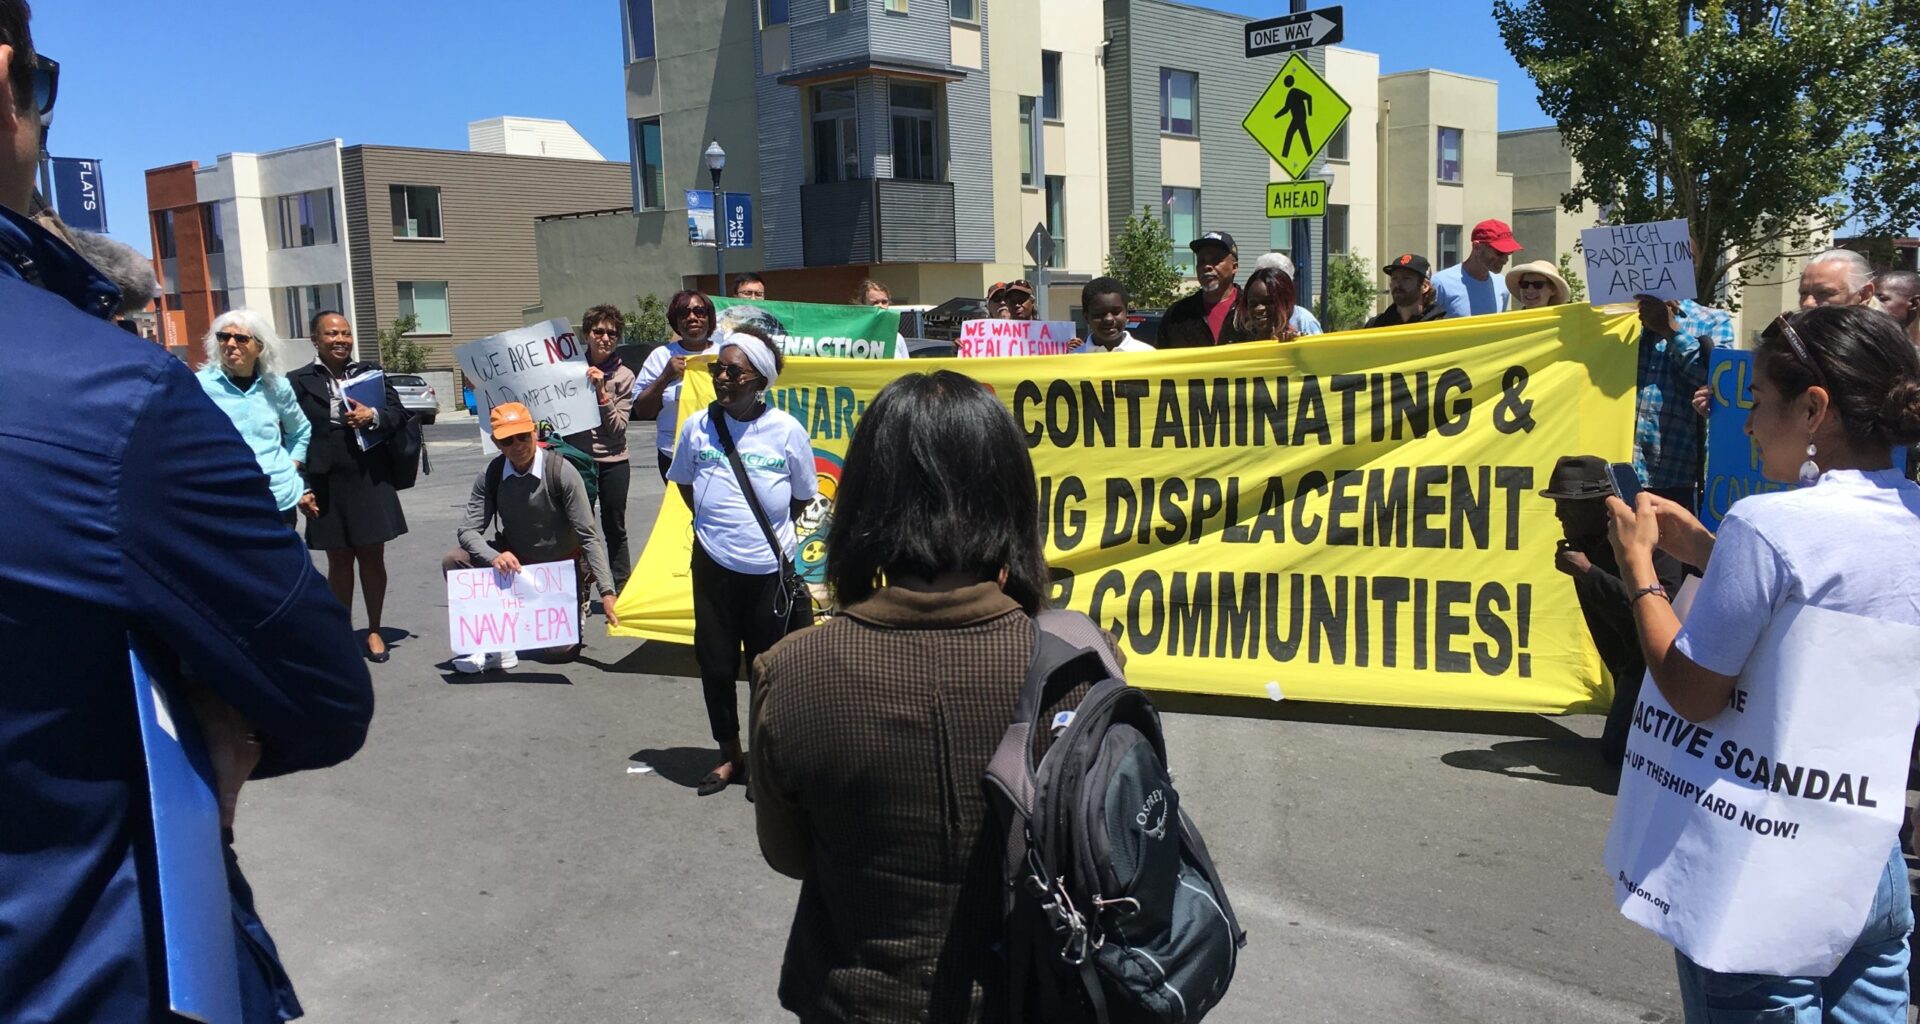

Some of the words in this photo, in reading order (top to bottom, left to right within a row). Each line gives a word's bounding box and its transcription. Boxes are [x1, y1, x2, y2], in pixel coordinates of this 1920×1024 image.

[1254, 28, 1280, 46] ONE
[1285, 22, 1313, 42] WAY
[79, 161, 96, 211] FLATS
[1273, 190, 1319, 209] AHEAD
[729, 219, 737, 246] NEW
[735, 205, 745, 246] HOMES
[1611, 223, 1662, 245] HIGH
[1585, 240, 1693, 268] RADIATION
[1608, 266, 1677, 295] AREA
[966, 321, 986, 337] WE
[991, 322, 1031, 339] WANT
[1040, 323, 1052, 339] A
[471, 352, 507, 382] WE
[508, 340, 544, 373] ARE
[544, 332, 579, 365] NOT
[498, 379, 578, 408] DMPING
[1013, 367, 1473, 449] CONTAMINATING
[1493, 365, 1537, 434] &
[1100, 465, 1534, 551] DISPLACEMENT
[533, 566, 562, 594] ON
[501, 596, 526, 609] THE
[459, 611, 520, 647] NAVY
[535, 606, 573, 642] EPA
[1088, 568, 1532, 678] COMMUNITIES!
[1631, 700, 1714, 759] ACTIVE
[1714, 739, 1878, 808] SCANDAL
[1136, 788, 1163, 826] OSPREY
[1631, 751, 1646, 771] UP
[1739, 812, 1800, 840] NOW!
